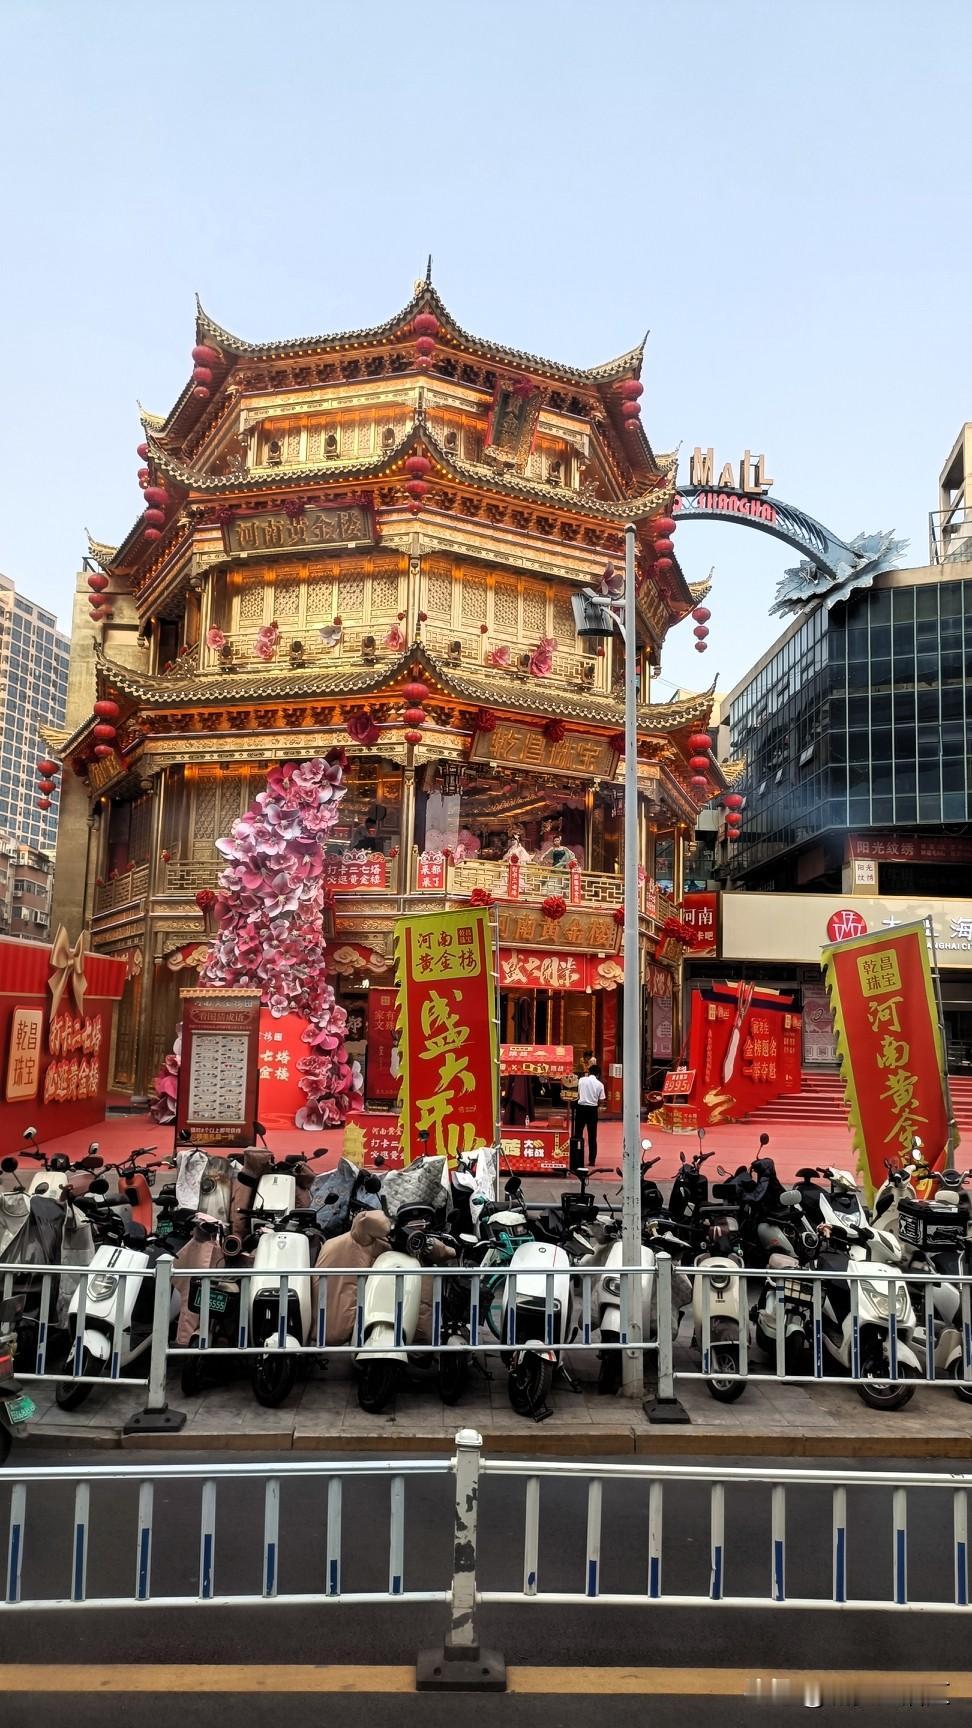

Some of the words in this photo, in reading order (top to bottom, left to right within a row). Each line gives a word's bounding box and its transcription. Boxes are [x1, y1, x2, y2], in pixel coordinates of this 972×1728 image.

[691, 447, 773, 494] MALL
[697, 492, 777, 526] SHANGHAI
[857, 841, 914, 856] 阳光纹绣
[328, 865, 381, 875] 打卡二七塔
[417, 930, 453, 950] 河南
[416, 948, 477, 974] 黄金楼
[863, 956, 893, 975] 乾昌
[866, 973, 897, 991] 珠宝
[16, 1020, 38, 1051] 乾昌
[49, 1013, 101, 1055] 打卡二七塔
[13, 1056, 36, 1087] 珠宝
[415, 989, 487, 1169] 盛大开业
[867, 996, 929, 1178] 河南黄金
[524, 1139, 534, 1148] 大
[524, 1148, 545, 1158] 作战
